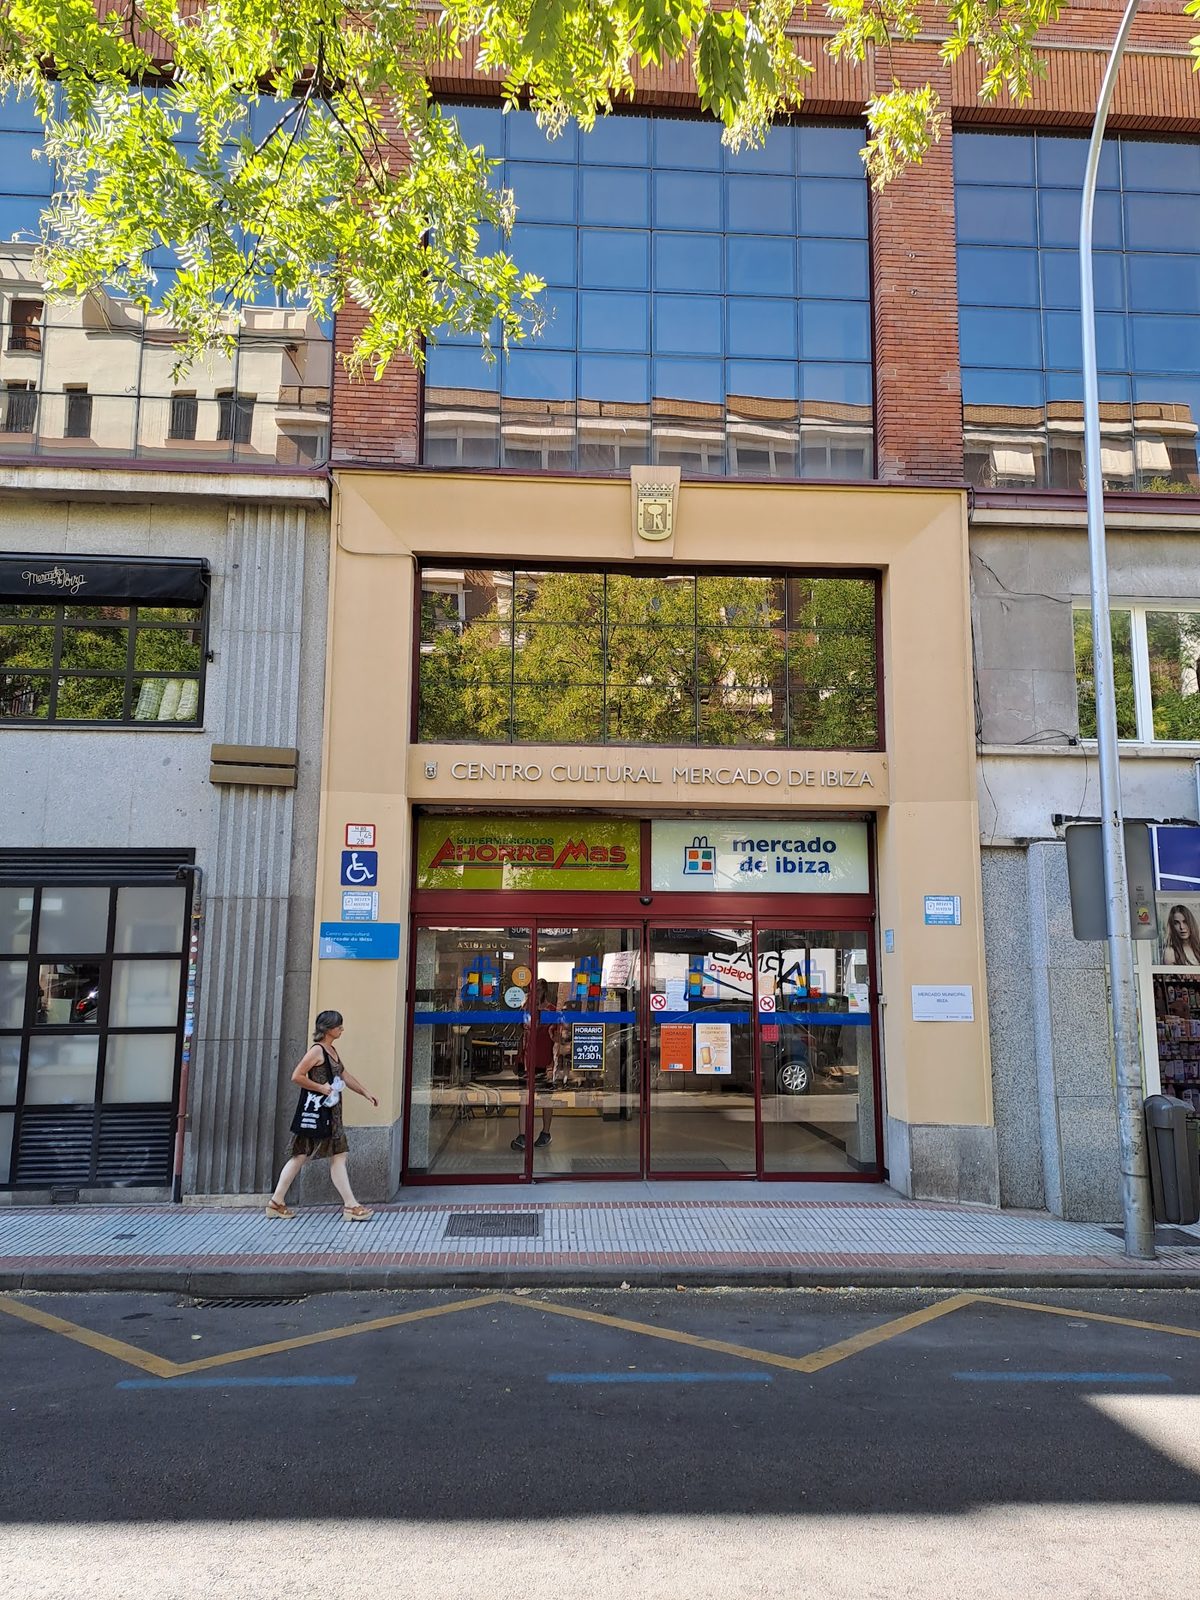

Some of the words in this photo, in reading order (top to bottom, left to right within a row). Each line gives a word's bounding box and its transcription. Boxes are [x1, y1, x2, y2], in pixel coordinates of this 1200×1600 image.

[451, 762, 543, 781] CENTRO
[550, 764, 662, 783] CULTURAL
[672, 767, 781, 786] MERCADO
[788, 768, 815, 787] DE
[821, 769, 875, 787] IBIZA
[456, 837, 554, 845] SUPERMERCADOS
[733, 837, 836, 853] mercado
[739, 856, 767, 873] de
[776, 856, 830, 874] ibiza
[577, 1052, 595, 1060] 21:30
